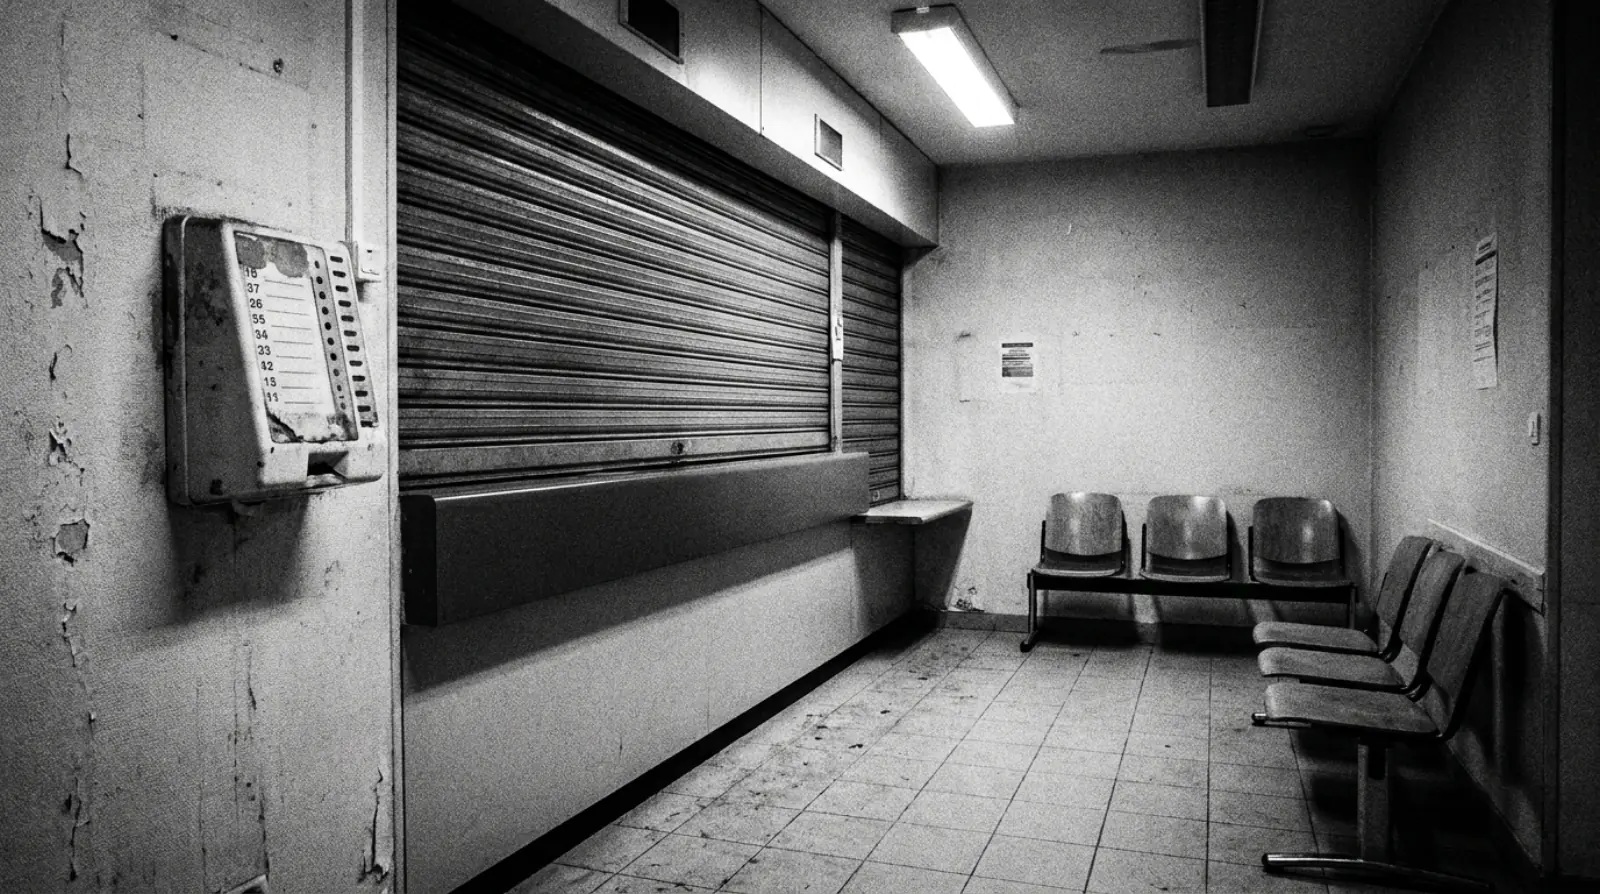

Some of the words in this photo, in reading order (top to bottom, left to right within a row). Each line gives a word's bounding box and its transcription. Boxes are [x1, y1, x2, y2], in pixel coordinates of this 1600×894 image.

[247, 283, 259, 293] 37
[250, 298, 263, 309] 26
[255, 329, 268, 340] 34
